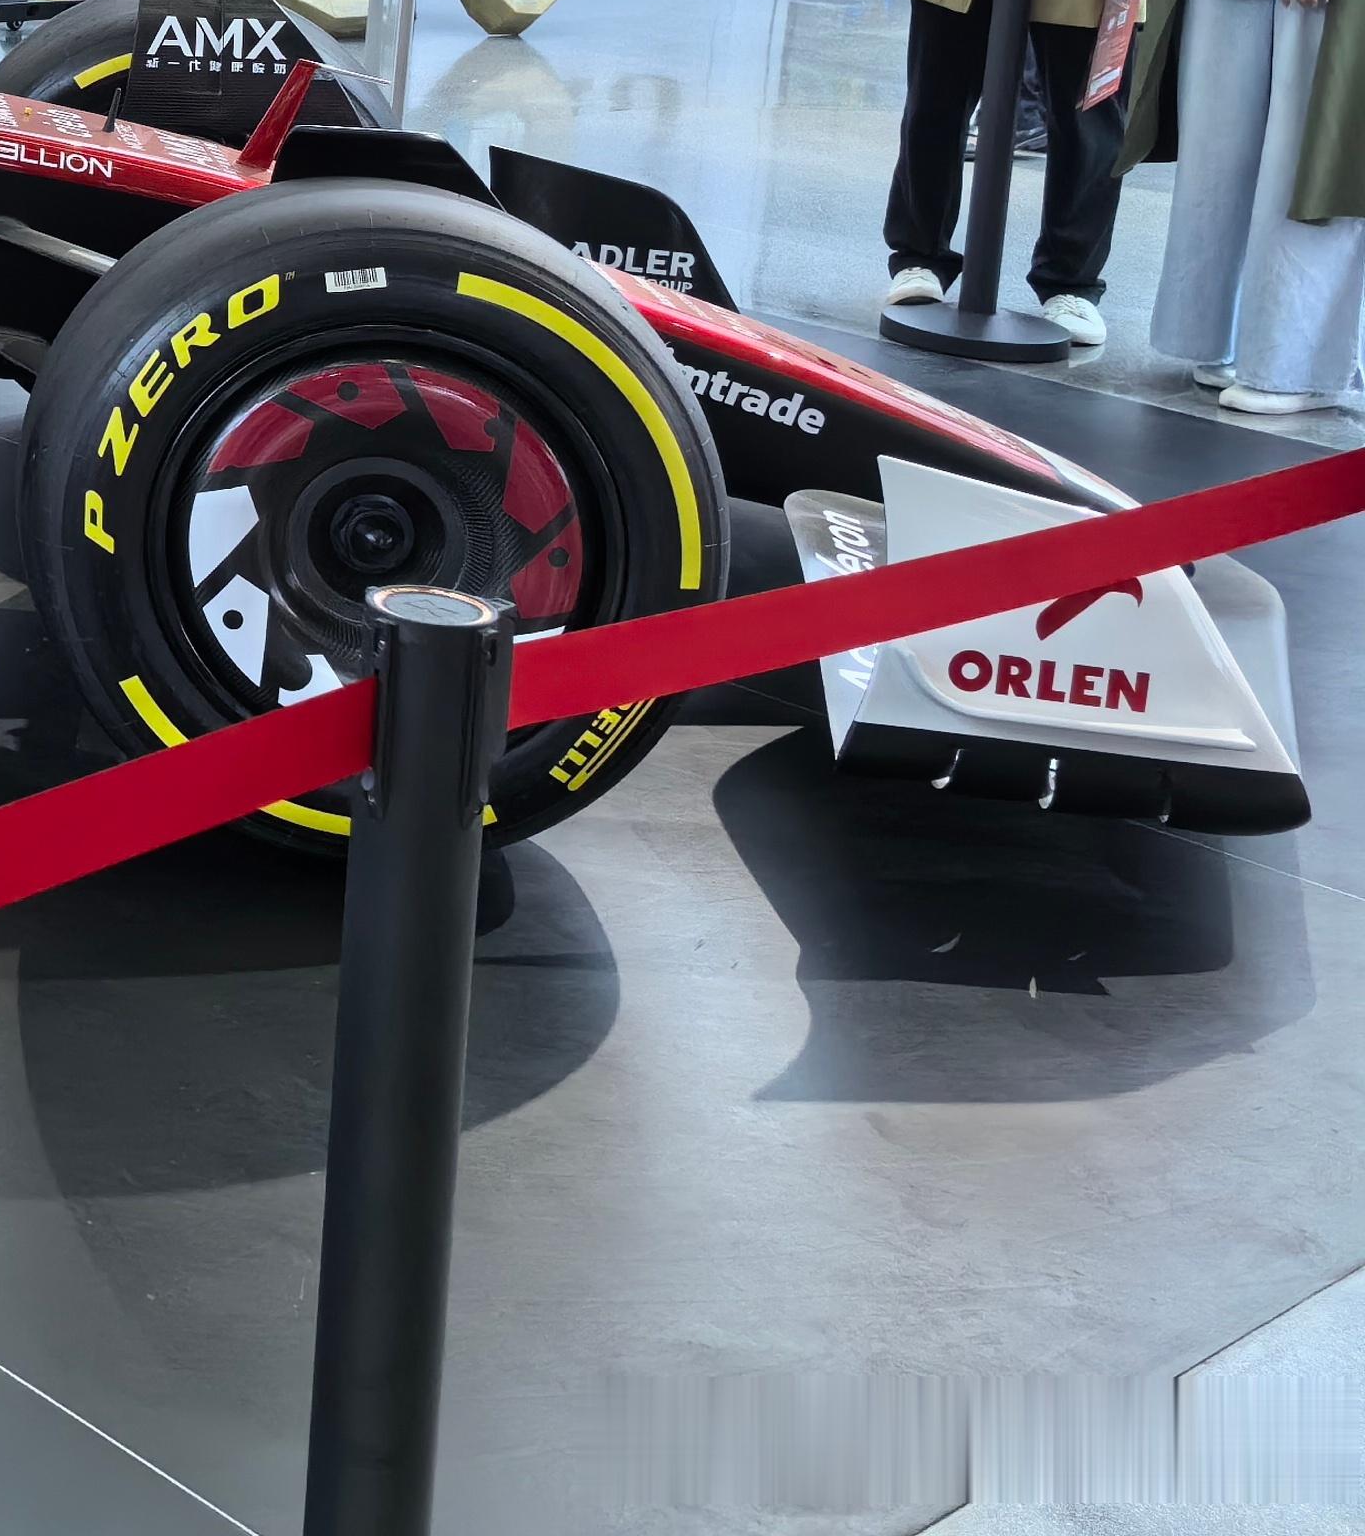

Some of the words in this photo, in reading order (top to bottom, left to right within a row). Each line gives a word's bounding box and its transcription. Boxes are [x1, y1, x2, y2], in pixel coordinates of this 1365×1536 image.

[146, 15, 288, 60] AMX
[97, 274, 280, 477] ZERO
[83, 490, 116, 555] P
[948, 649, 1151, 714] ORLEN
